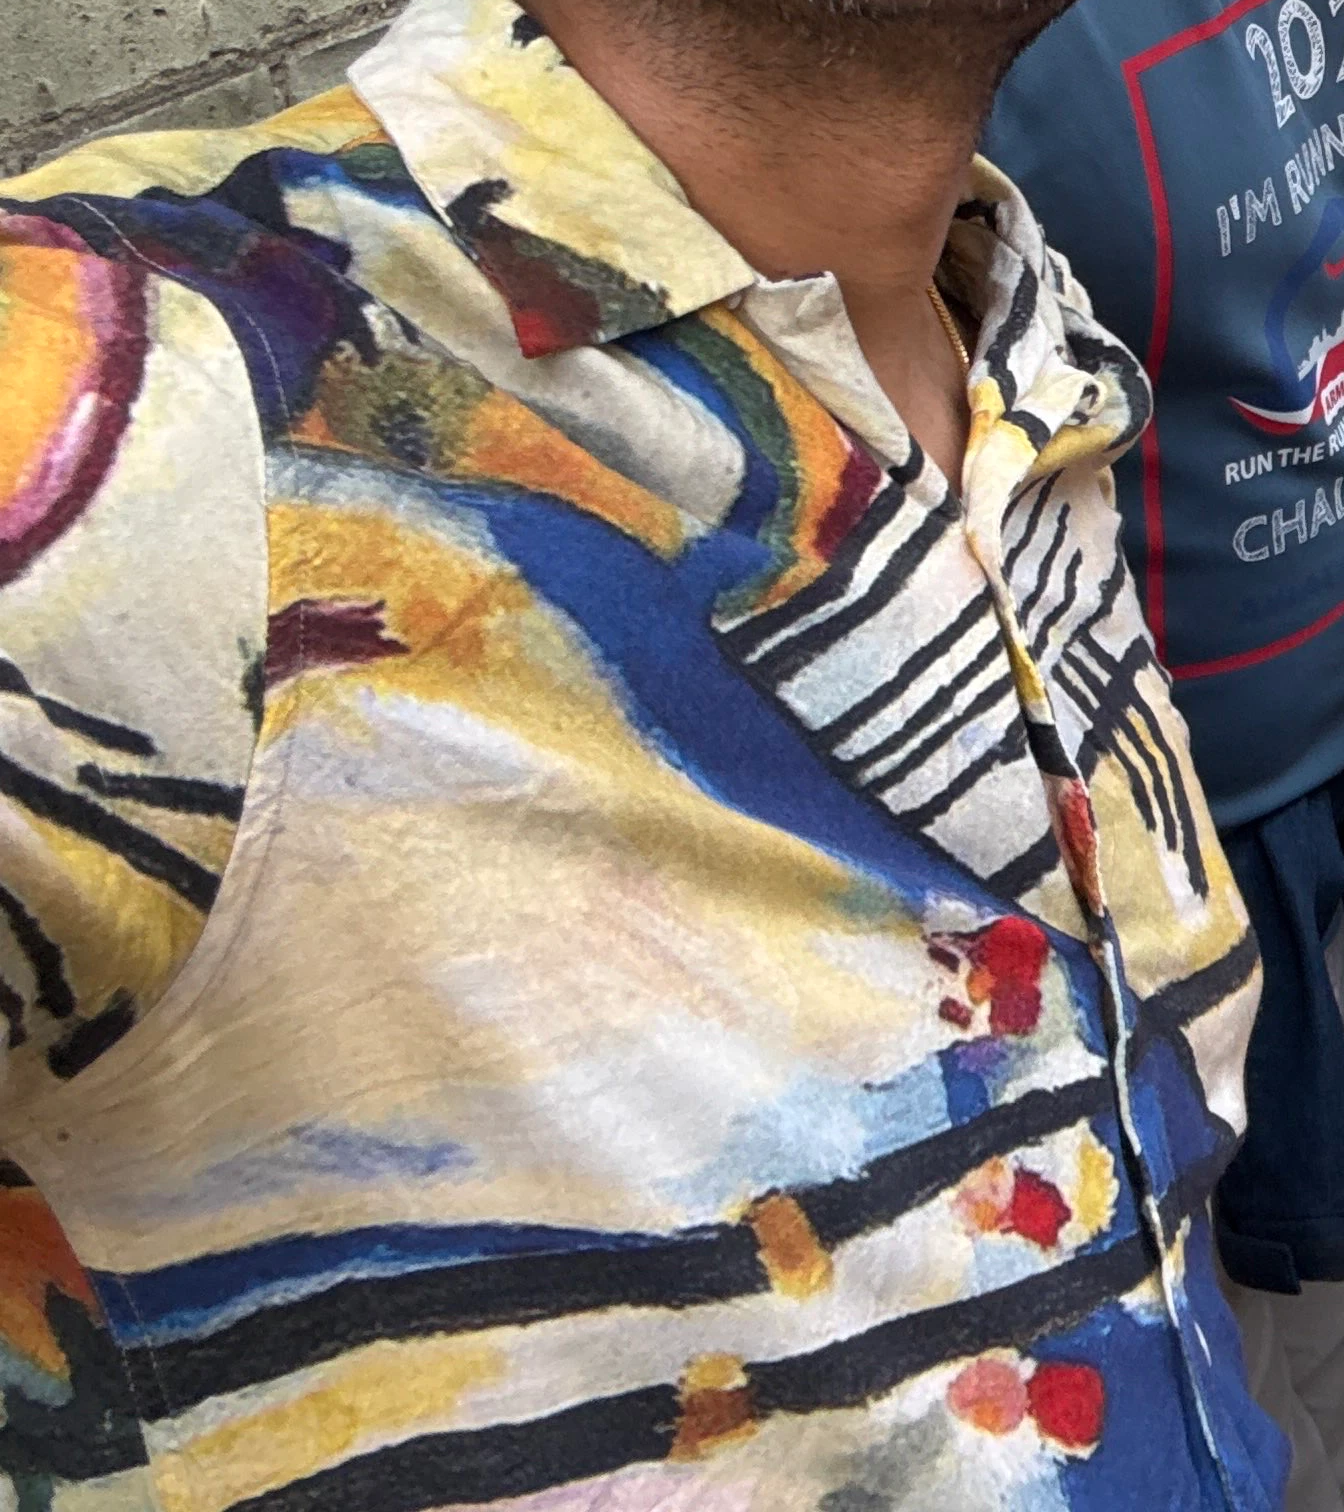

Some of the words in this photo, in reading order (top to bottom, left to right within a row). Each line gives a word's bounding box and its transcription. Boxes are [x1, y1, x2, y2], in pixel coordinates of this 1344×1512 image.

[1215, 176, 1282, 257] I'M
[1225, 451, 1273, 485] RUN
[1277, 441, 1325, 467] THE
